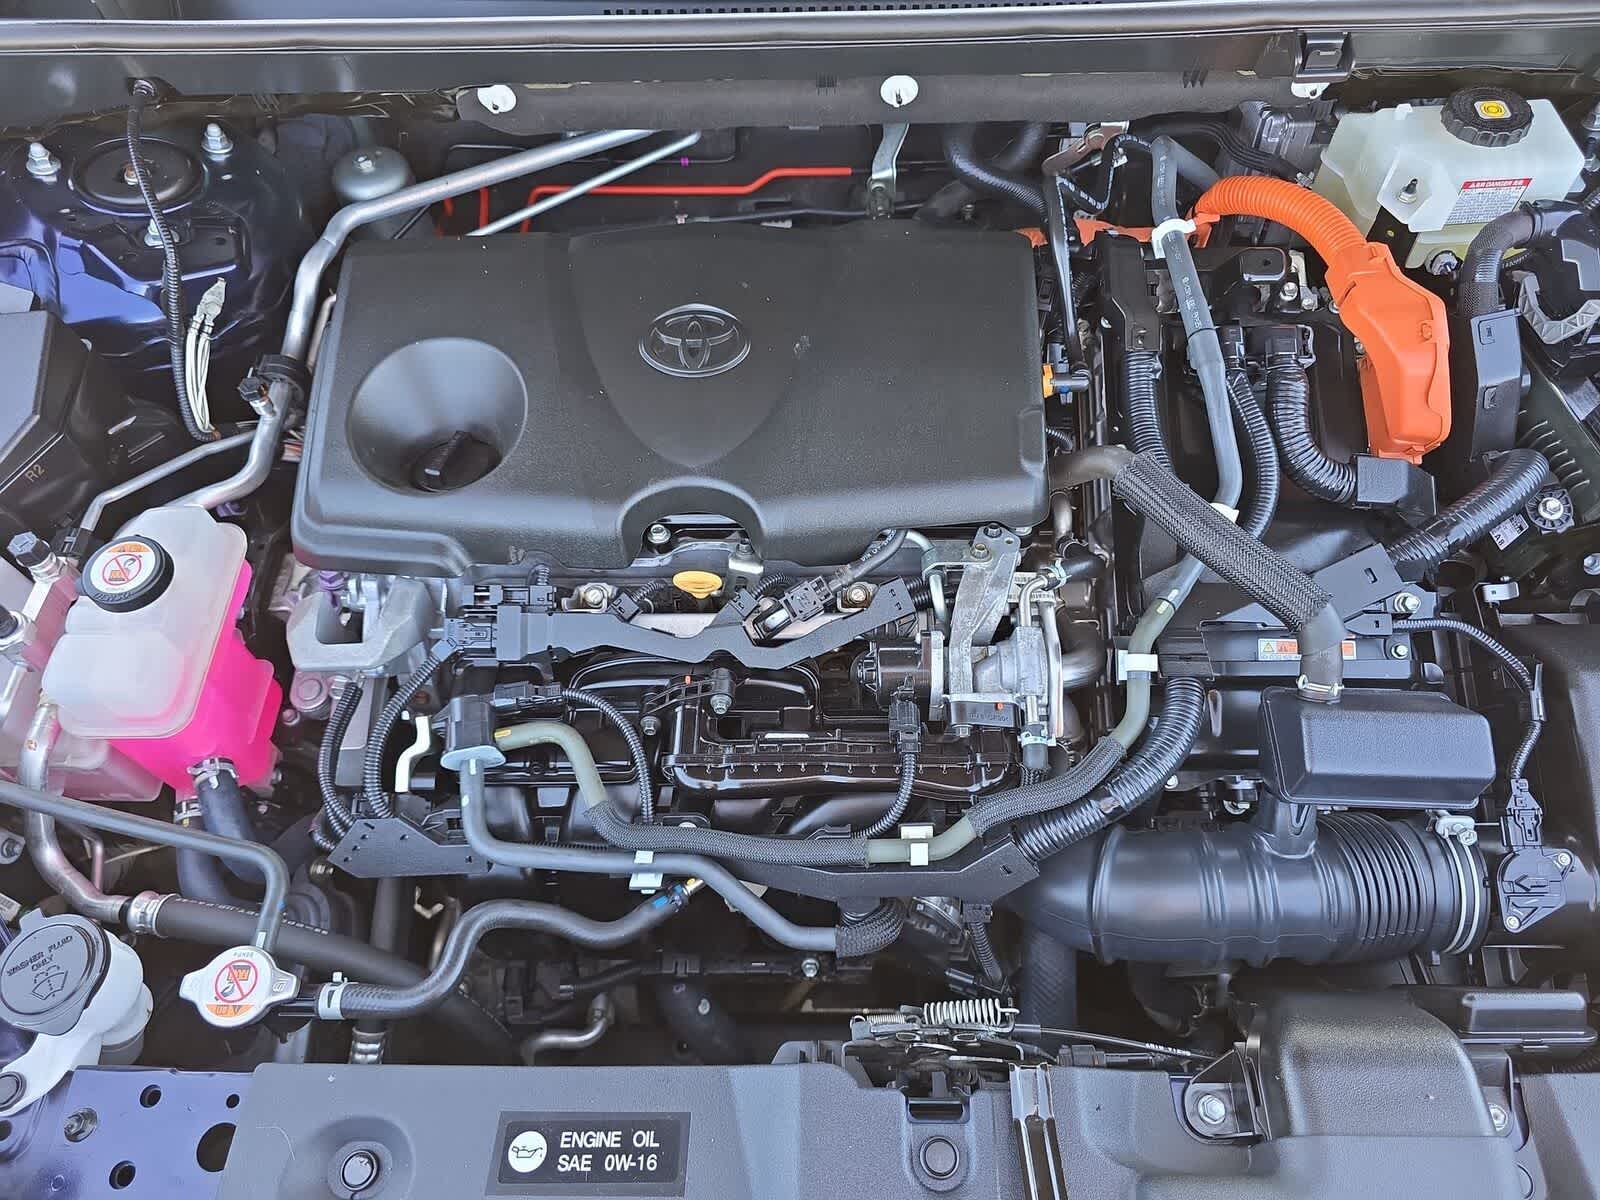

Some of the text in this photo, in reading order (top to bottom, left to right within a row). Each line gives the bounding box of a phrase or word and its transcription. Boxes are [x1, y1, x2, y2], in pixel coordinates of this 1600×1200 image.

[25, 464, 45, 482] R2
[7, 935, 73, 977] WASHER FLUID
[31, 953, 54, 972] ONLY
[559, 1130, 660, 1149] ENGINE OIL
[556, 1153, 658, 1172] SAE 0W-16
